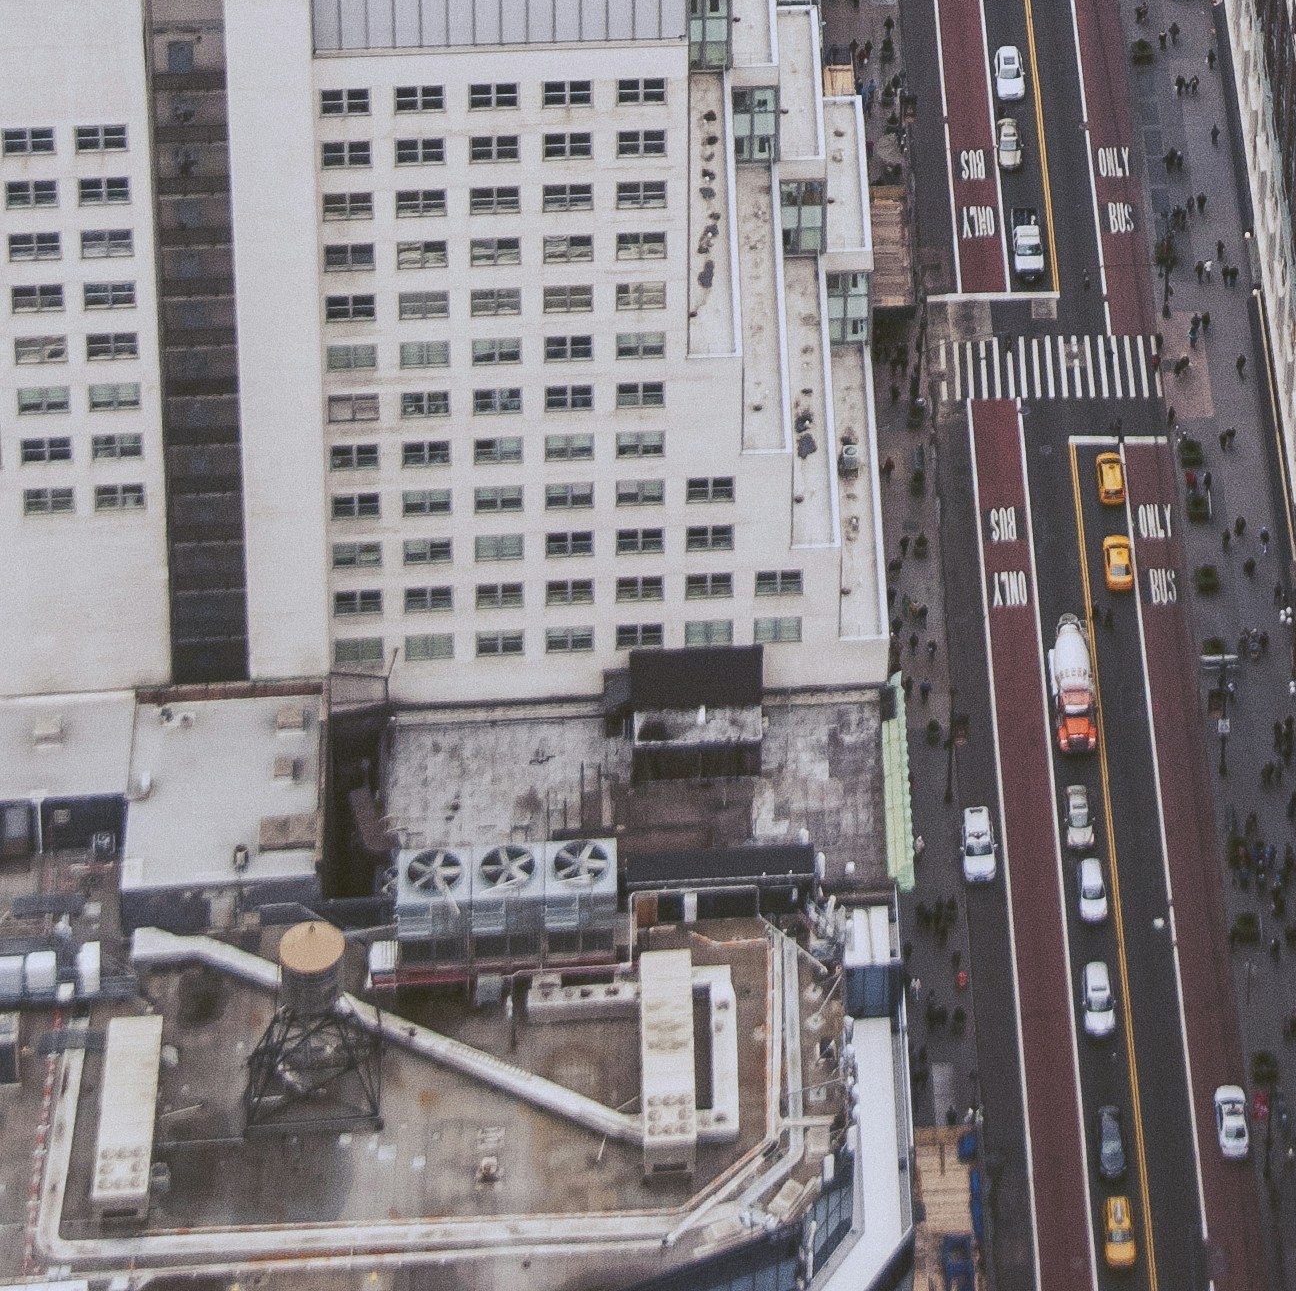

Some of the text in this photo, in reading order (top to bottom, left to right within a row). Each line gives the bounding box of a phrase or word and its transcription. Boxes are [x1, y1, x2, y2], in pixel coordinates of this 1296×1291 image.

[960, 149, 986, 180] BUS
[1098, 147, 1130, 178] ONLY
[962, 205, 995, 239] ONLY
[1107, 202, 1135, 234] BUS
[989, 506, 1017, 541] BUS
[1138, 504, 1172, 539] ONLY
[993, 570, 1028, 607] ONLY
[1149, 568, 1177, 605] BUS
